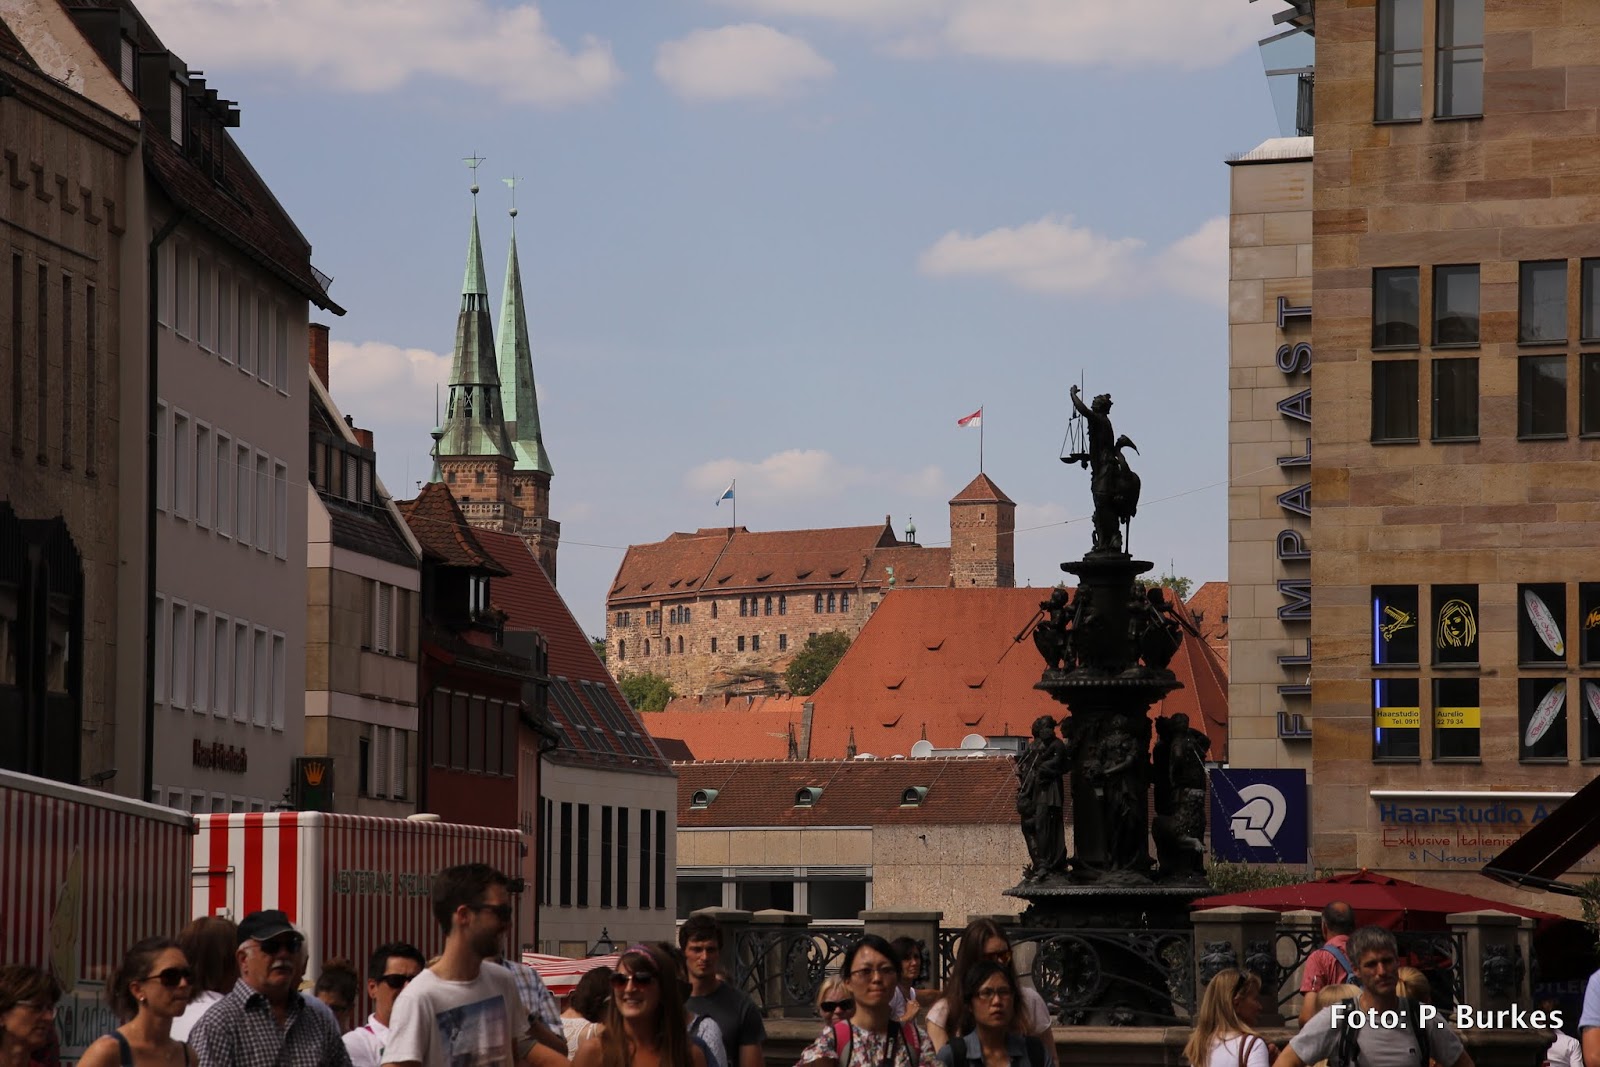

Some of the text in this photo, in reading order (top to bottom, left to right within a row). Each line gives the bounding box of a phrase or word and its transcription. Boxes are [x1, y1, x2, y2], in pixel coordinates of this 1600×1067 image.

[1276, 296, 1312, 738] FILMPALAST
[1380, 802, 1548, 823] Haarstudio A
[1381, 828, 1450, 847] Exklusive
[1408, 849, 1494, 865] & Nagelst
